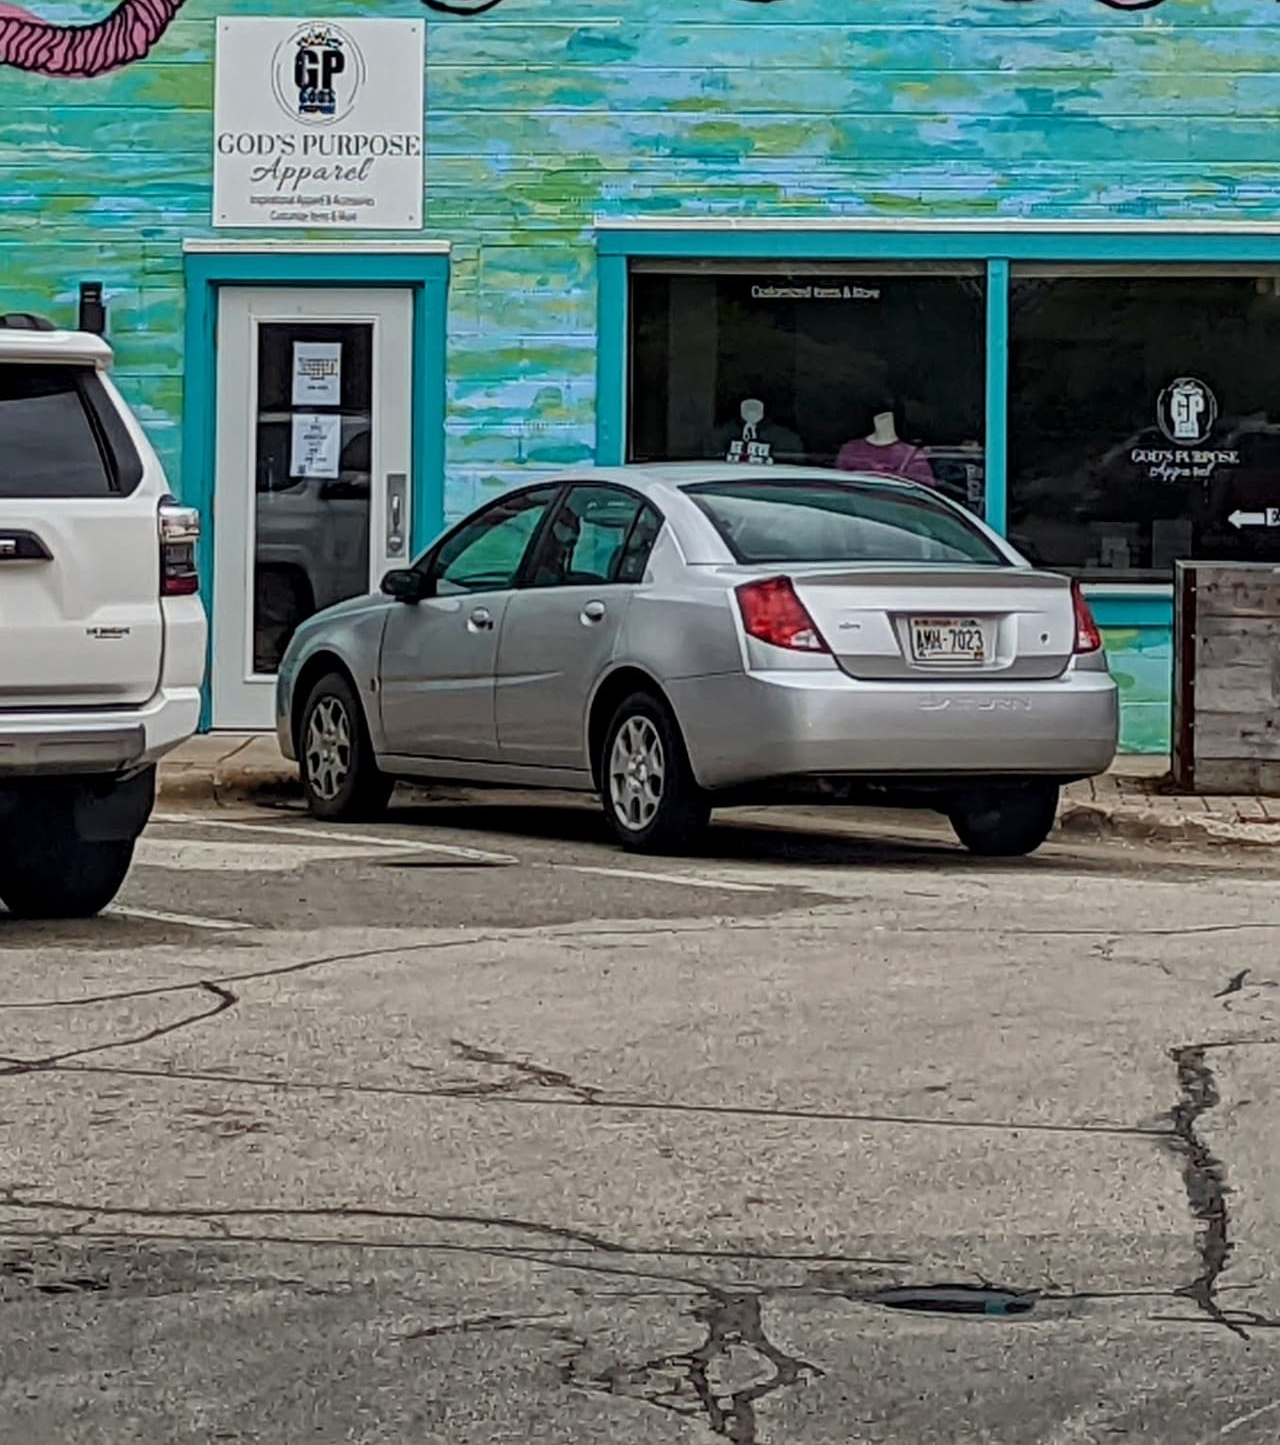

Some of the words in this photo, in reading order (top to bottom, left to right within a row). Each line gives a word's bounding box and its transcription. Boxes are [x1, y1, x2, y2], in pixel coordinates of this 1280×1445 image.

[217, 132, 295, 155] GOD'S
[302, 133, 421, 156] PURPOSE
[249, 156, 375, 192] Apparel
[1175, 449, 1240, 464] PURPOSE
